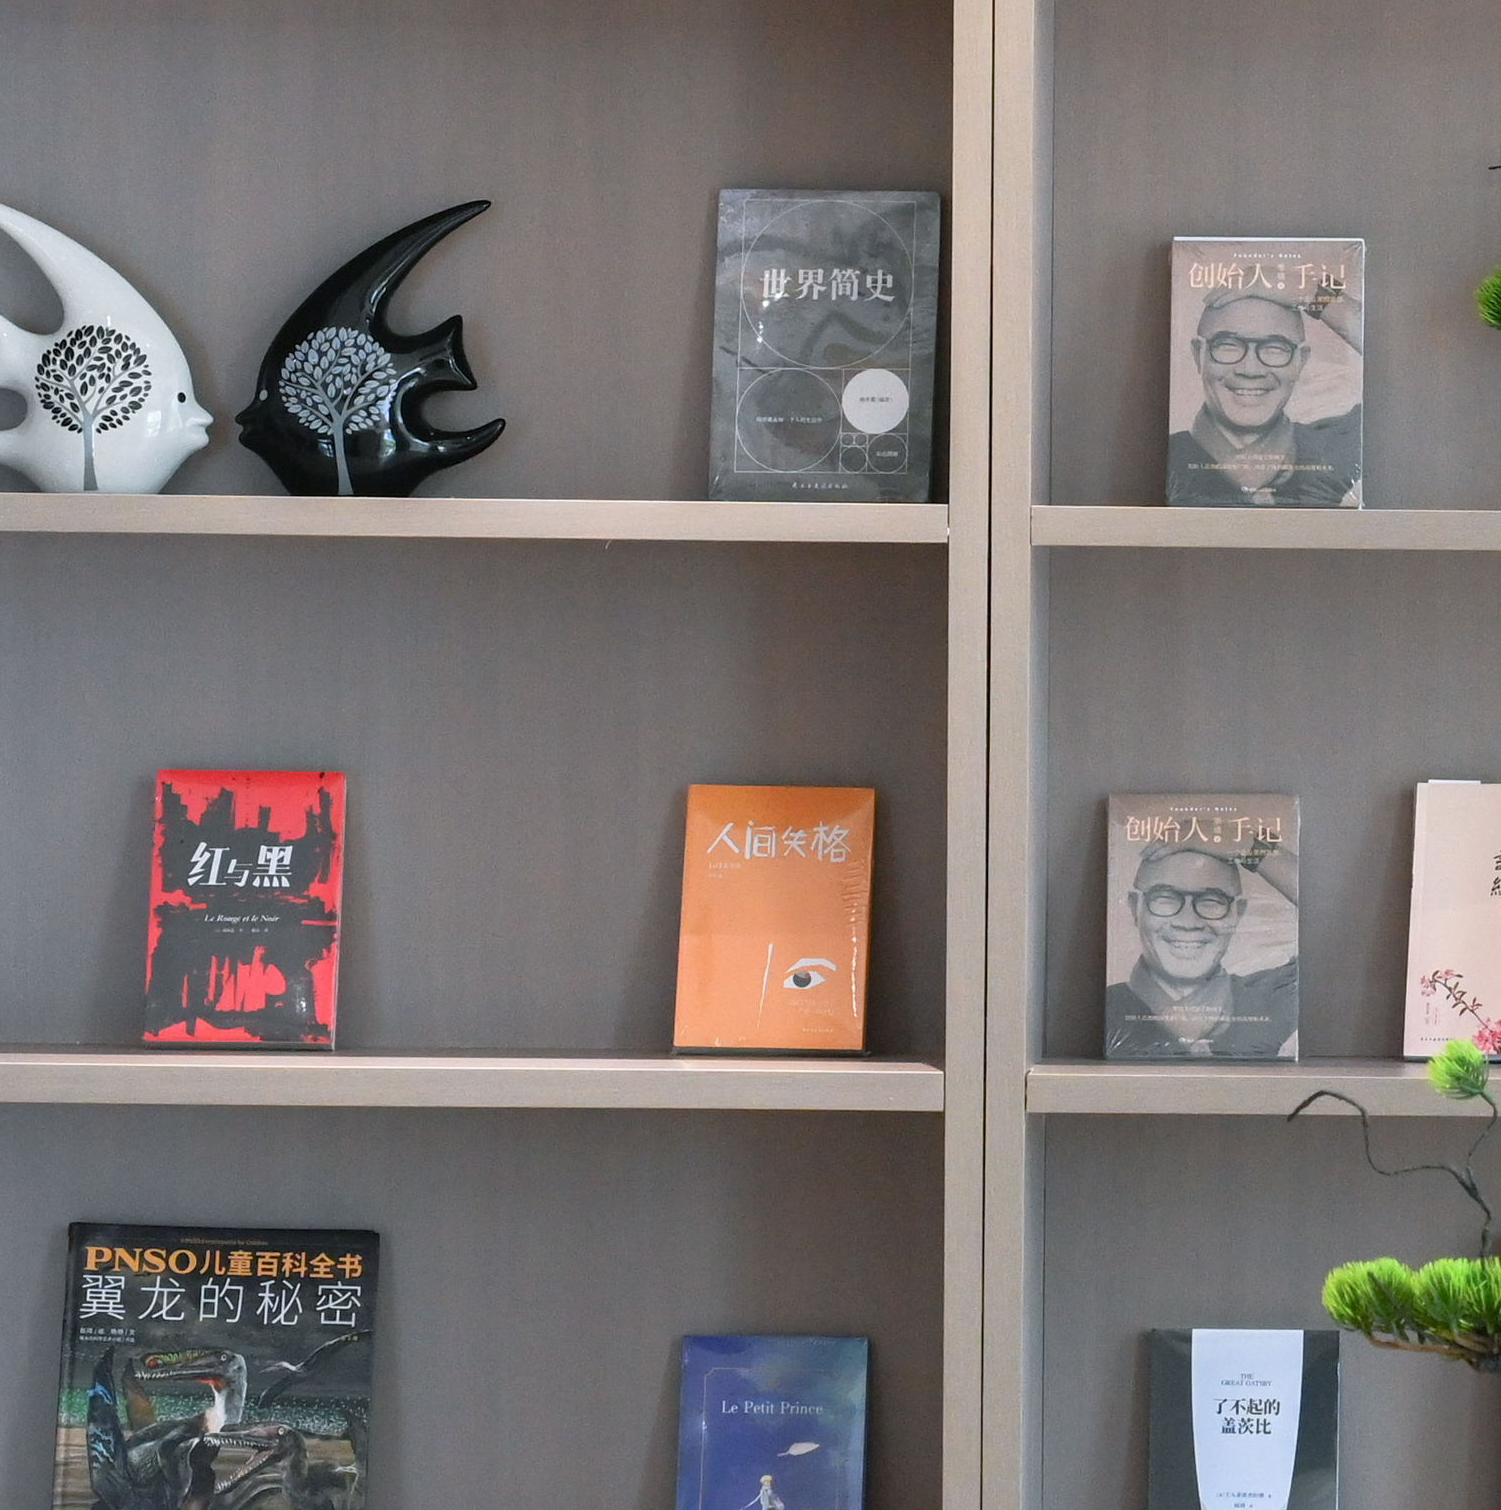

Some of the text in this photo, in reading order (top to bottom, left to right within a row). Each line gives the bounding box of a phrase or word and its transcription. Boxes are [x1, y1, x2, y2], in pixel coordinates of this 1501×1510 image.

[760, 268, 896, 302] 世界简史
[1188, 262, 1347, 290] 创始人 手记
[707, 820, 852, 863] 人间失格
[1125, 815, 1283, 843] 创始人 手记
[187, 841, 293, 888] 红与黑
[204, 914, 216, 922] Le
[216, 914, 242, 924] Rouge
[260, 914, 280, 923] Noir
[79, 1274, 362, 1328] 翼龙的秘密
[721, 1400, 824, 1416] Le Petit Prince
[1212, 1397, 1281, 1417] 了不起的
[1221, 1417, 1273, 1436] 盖茨比
